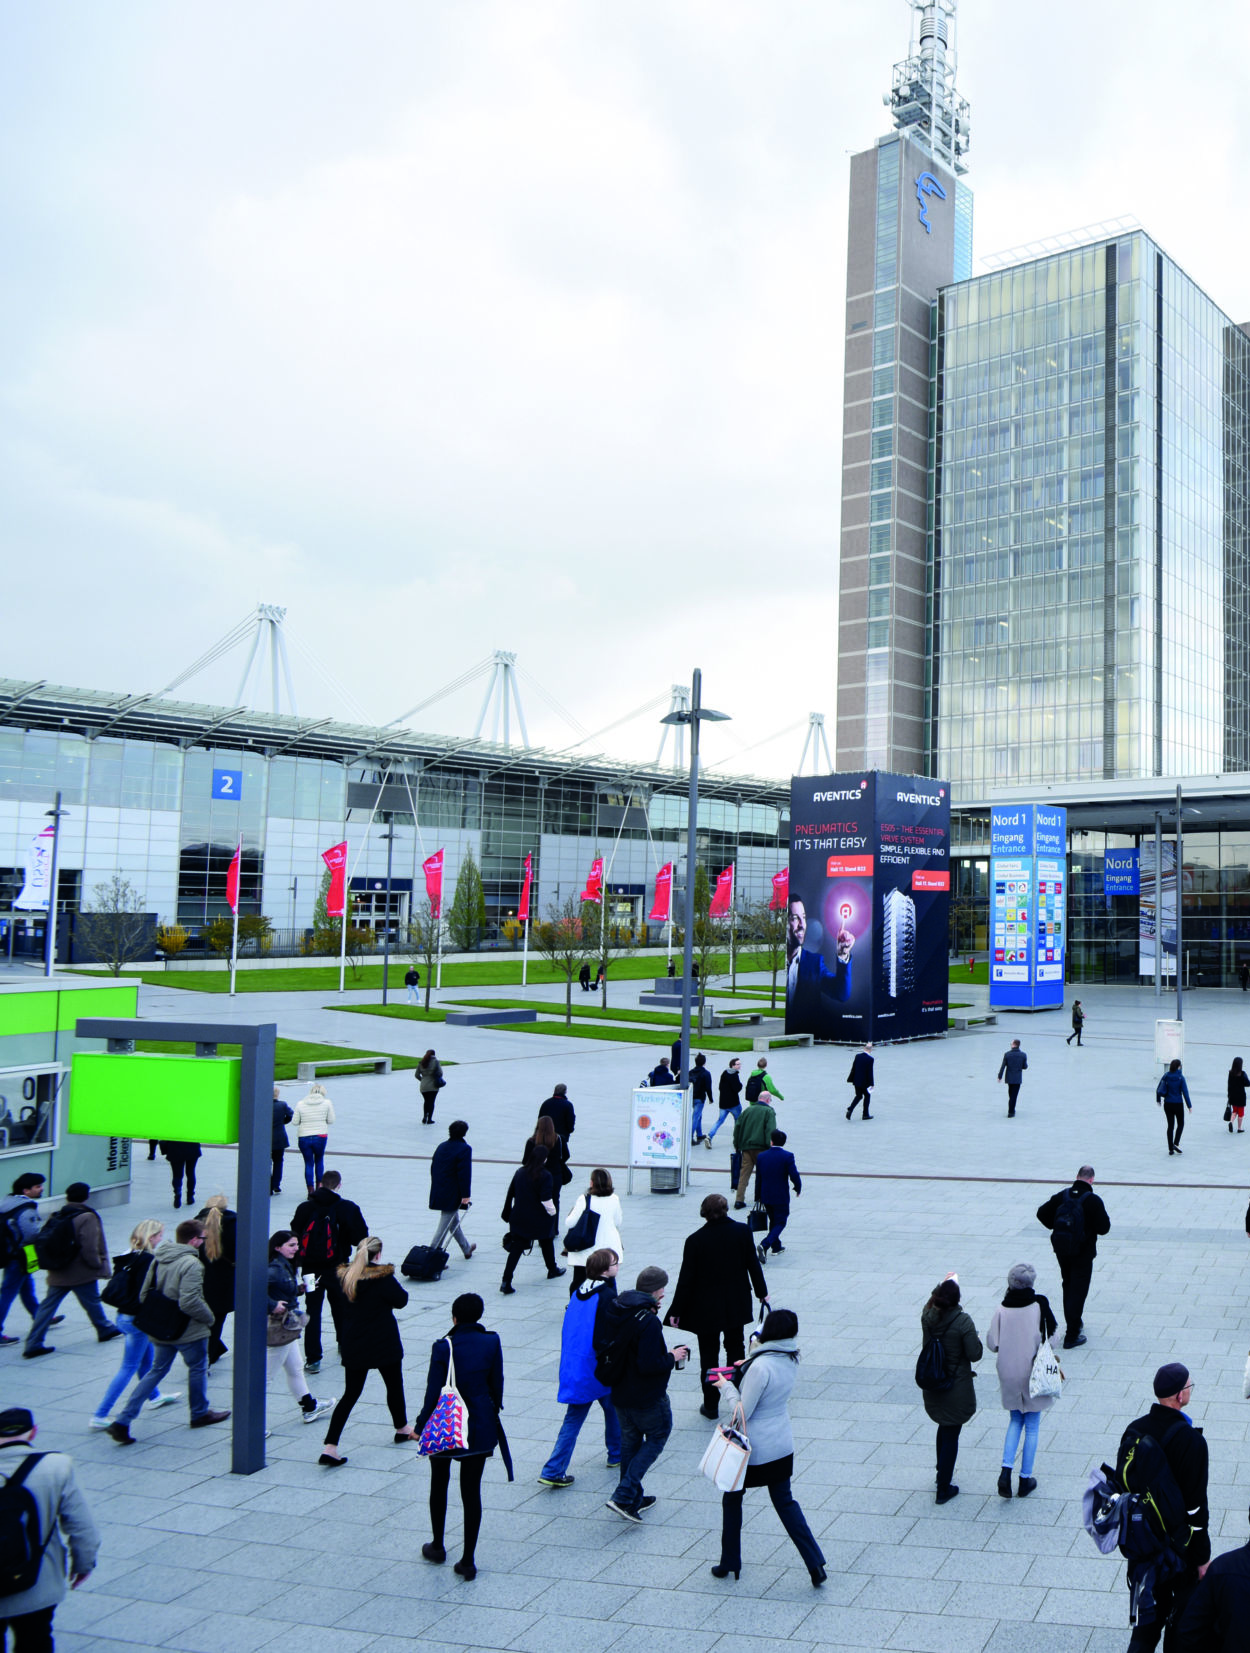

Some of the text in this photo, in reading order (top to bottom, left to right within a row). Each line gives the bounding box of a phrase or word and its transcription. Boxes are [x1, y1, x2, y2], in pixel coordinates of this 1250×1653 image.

[220, 775, 234, 793] 2
[813, 789, 862, 802] AVENTICS
[896, 791, 941, 806] AVENTICS
[993, 813, 1026, 826] Nord 1
[1036, 813, 1062, 827] Nord 1
[795, 822, 858, 835] PNEUMATICS
[902, 824, 914, 834] THE
[915, 826, 945, 837] ESSENTIAL
[794, 836, 867, 850] IT'S THAT EASY
[880, 834, 925, 845] VALVE SYSTEM
[992, 833, 1024, 844] Eingang
[1036, 832, 1060, 844] Eingang
[880, 844, 945, 857] SIMPLE, FLEXIBLE AND
[992, 844, 1026, 854] Entrance
[1036, 843, 1061, 854] Entrance
[880, 855, 910, 865] EFFICIENT
[1106, 857, 1133, 869] Nord
[1106, 874, 1132, 884] Eingang
[1106, 884, 1134, 892] Entrance
